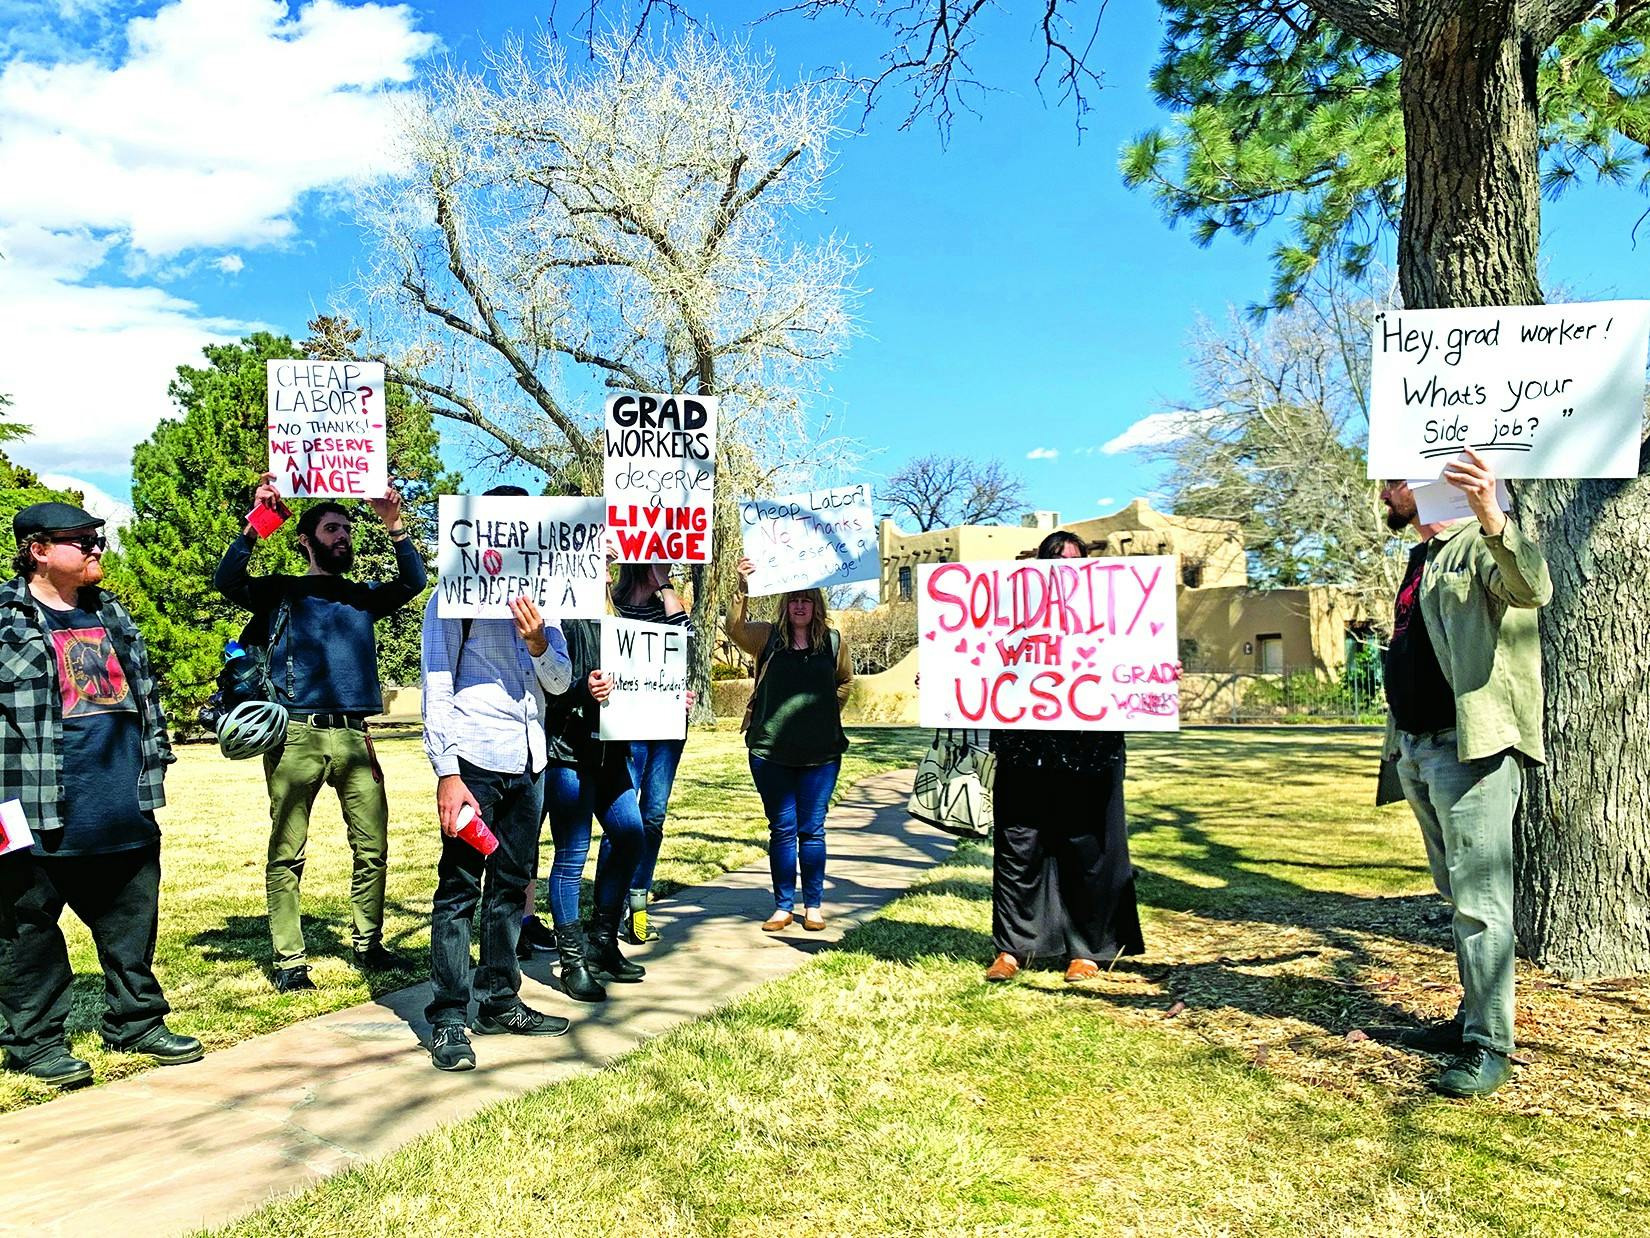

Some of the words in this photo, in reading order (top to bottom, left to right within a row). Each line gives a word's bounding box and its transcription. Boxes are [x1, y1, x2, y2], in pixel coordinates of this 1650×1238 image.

[1445, 319, 1499, 366] grad
[1521, 317, 1613, 345] worker!
[276, 364, 361, 390] CHEAP
[275, 386, 374, 415] LABOR?
[1403, 375, 1487, 408] What's
[1501, 378, 1573, 412] your
[612, 395, 708, 431] GRAD
[605, 429, 710, 460] WORKERS
[1424, 415, 1468, 444] Side
[271, 440, 297, 454] WE
[303, 438, 375, 454] DESERVE
[286, 455, 299, 472] A
[308, 453, 369, 473] LIVING
[291, 470, 365, 495] WAGE
[650, 494, 665, 509] a
[743, 502, 800, 525] Cheap
[810, 484, 865, 511] Labor?
[608, 505, 707, 531] LIVING
[761, 520, 792, 544] No
[450, 519, 529, 549] CHEAP
[538, 521, 606, 552] LABOR?
[616, 530, 706, 561] WAGE
[461, 549, 503, 575] NO
[518, 550, 601, 579] THANKS
[443, 575, 474, 605] WE
[478, 576, 548, 607] DESERVE
[560, 578, 577, 607] A
[927, 560, 1162, 635] SOLIDARITY
[617, 628, 679, 664] WTF
[1112, 663, 1176, 684] GRAD
[954, 671, 1108, 723] UCSC
